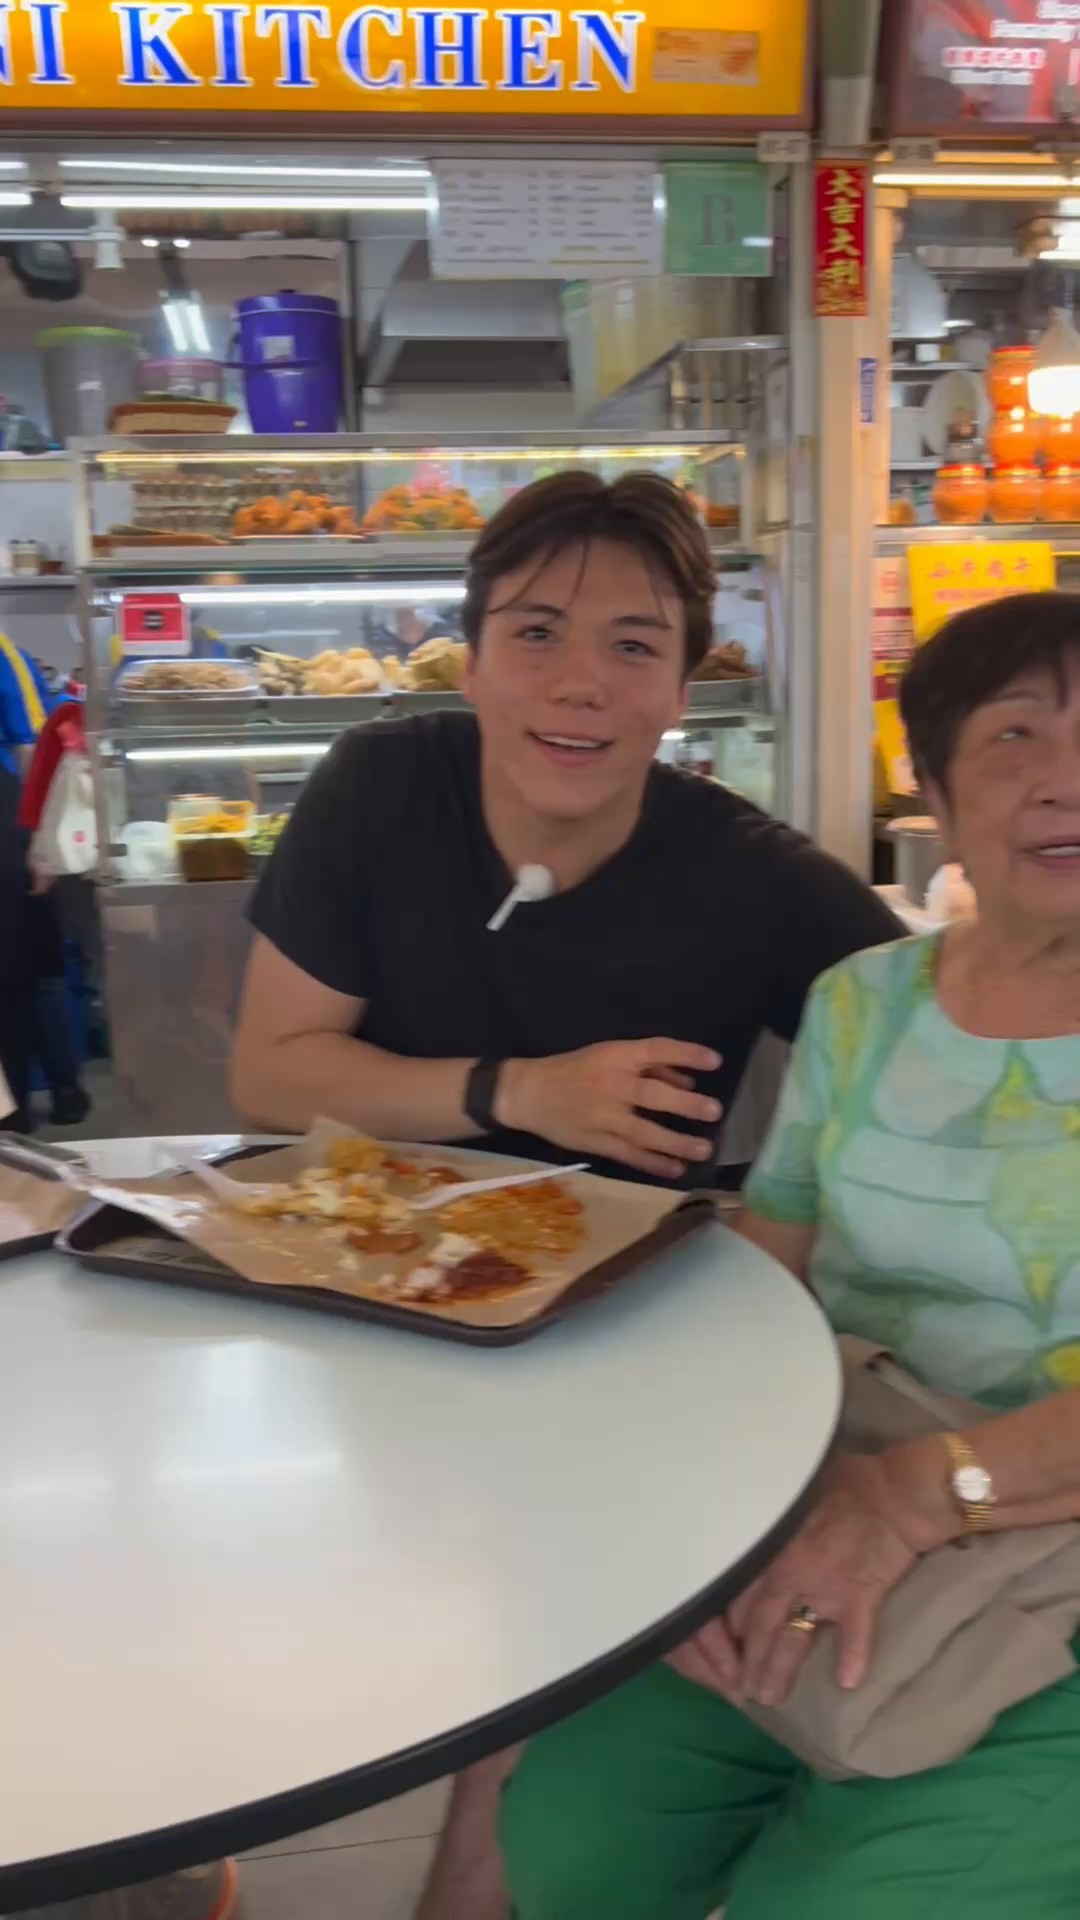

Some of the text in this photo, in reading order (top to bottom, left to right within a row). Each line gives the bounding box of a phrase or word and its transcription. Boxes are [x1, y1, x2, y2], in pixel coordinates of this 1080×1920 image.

[0, 0, 75, 85] I
[111, 2, 646, 93] KITCHEN
[699, 193, 738, 247] B
[822, 168, 863, 287] 大吉大利
